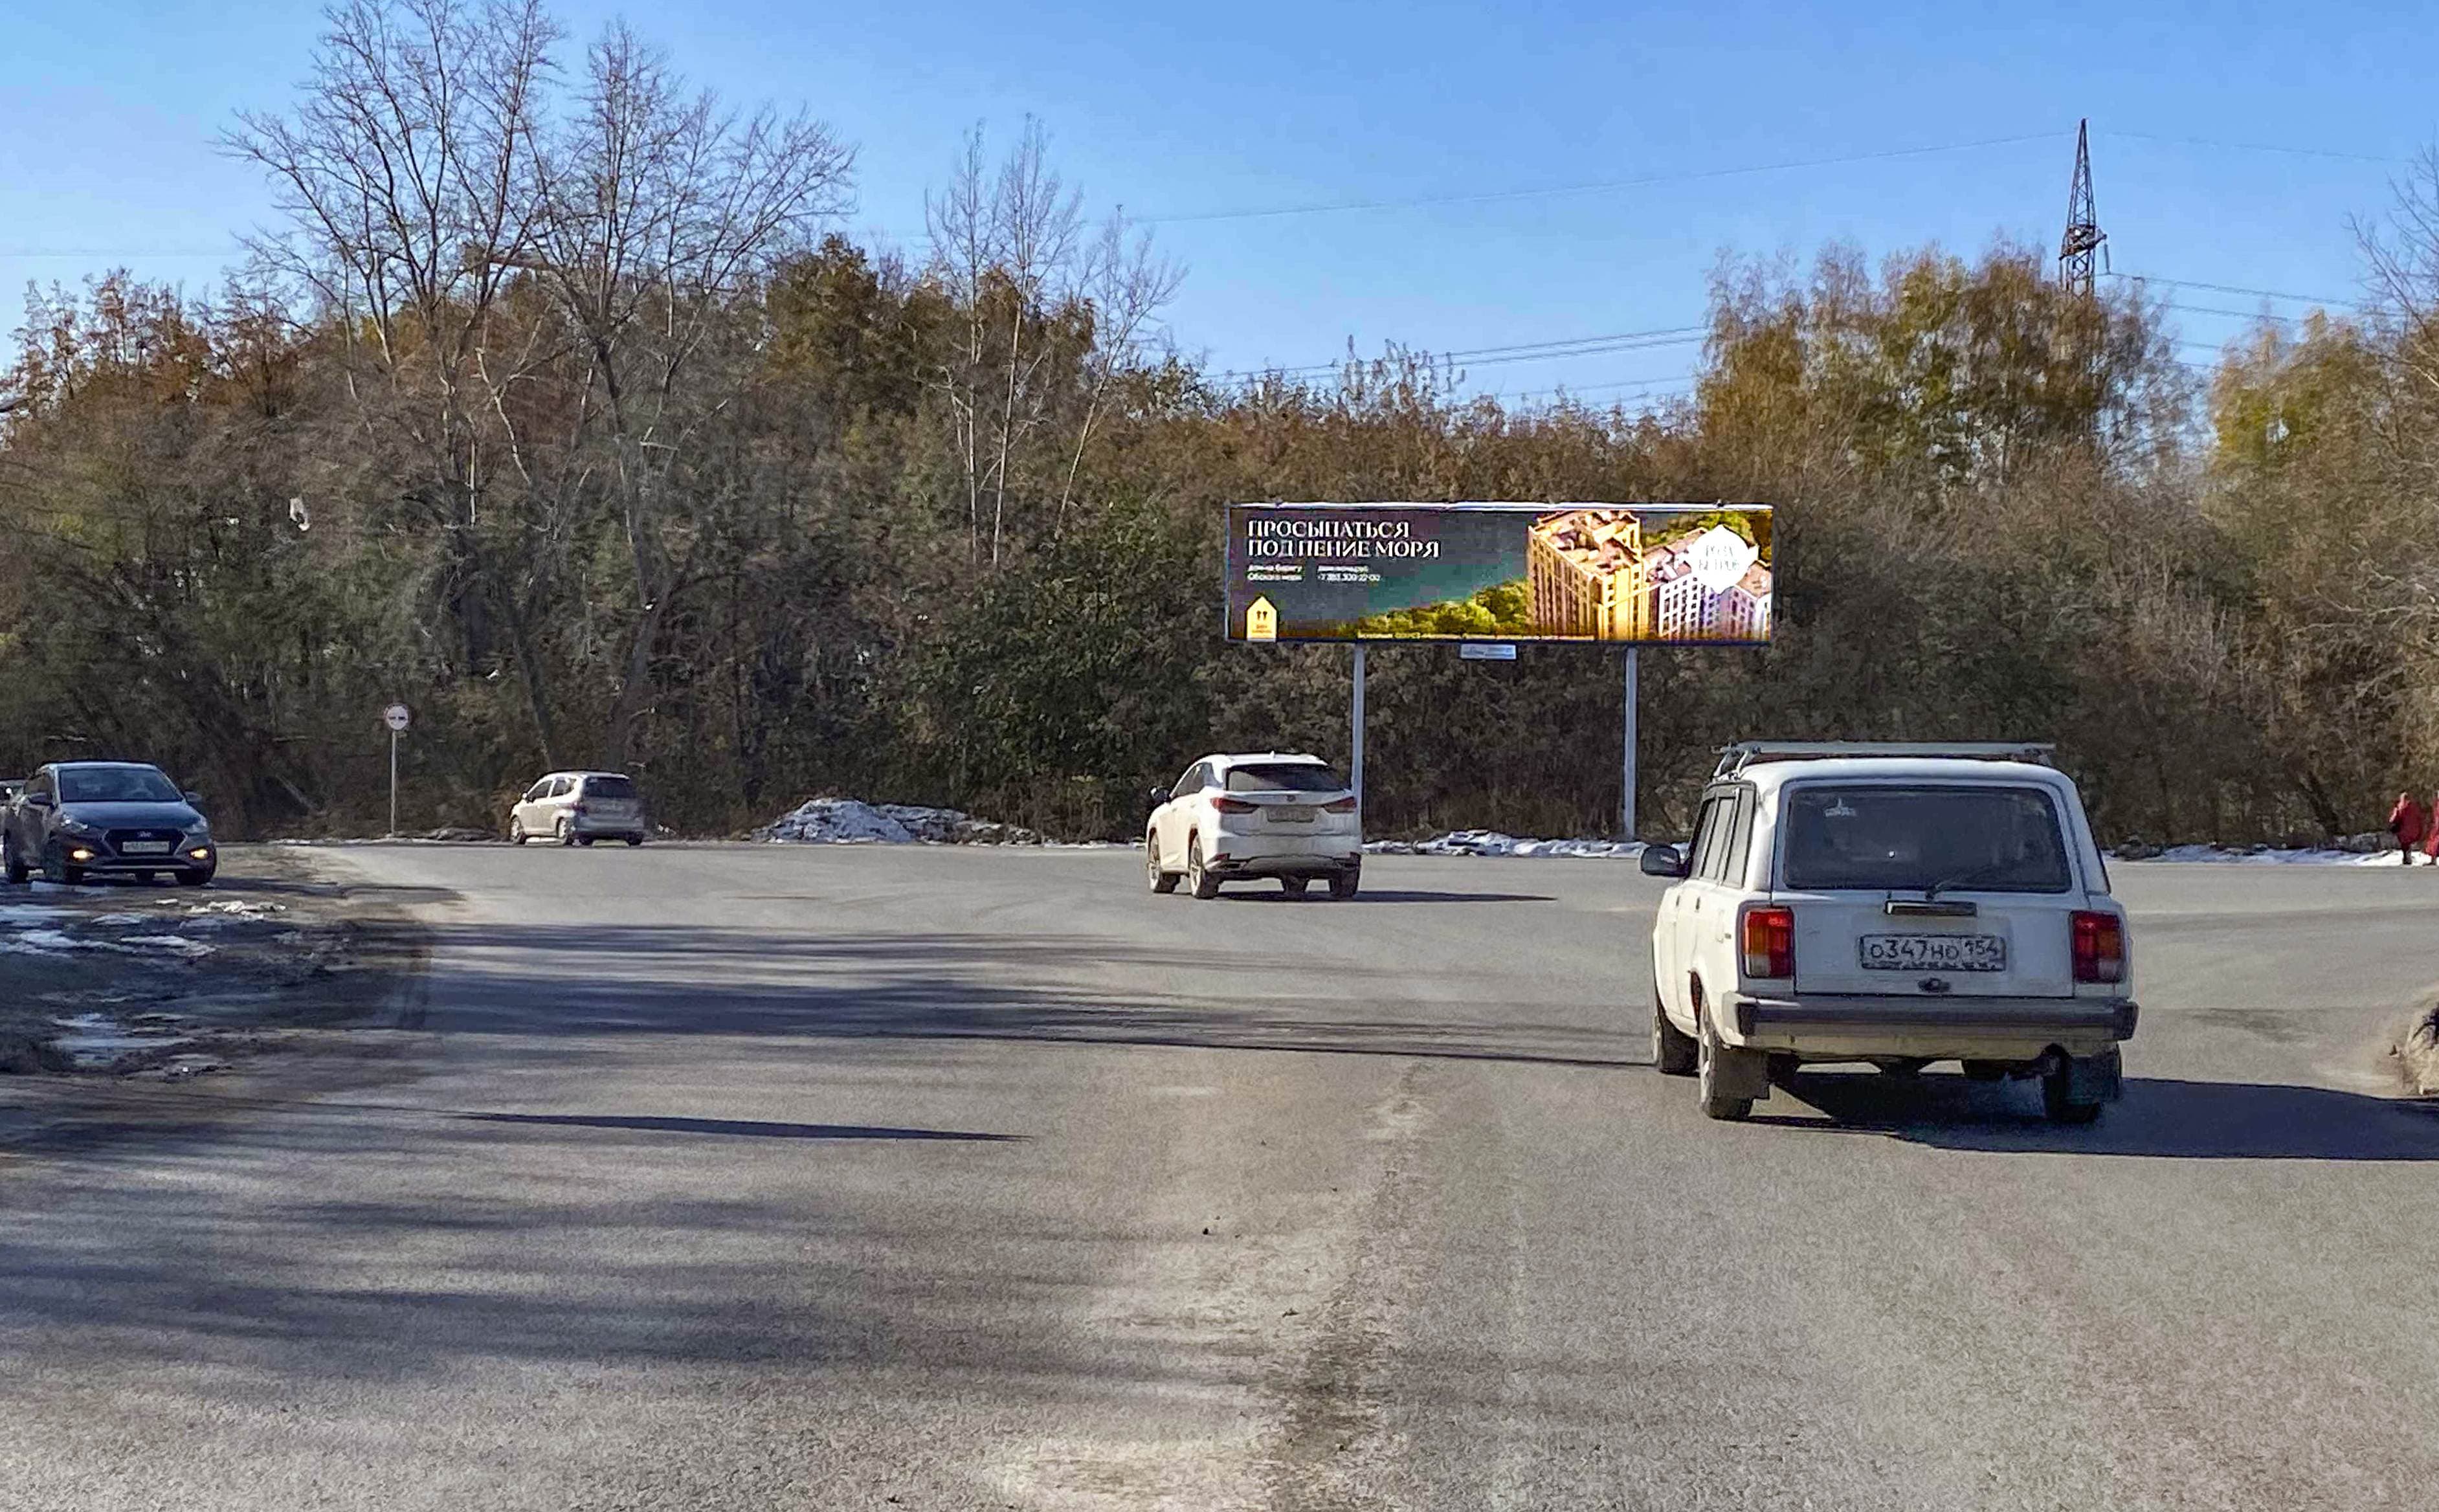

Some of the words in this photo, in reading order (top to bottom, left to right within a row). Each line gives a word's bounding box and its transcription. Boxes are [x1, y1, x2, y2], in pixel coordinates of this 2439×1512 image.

[1247, 520, 1410, 538] ПРОСЫПАТЬСЯ
[1247, 539, 1293, 557] ПОД
[1298, 540, 1371, 557] ПЕНИЕ
[1375, 540, 1440, 557] МОРЯ
